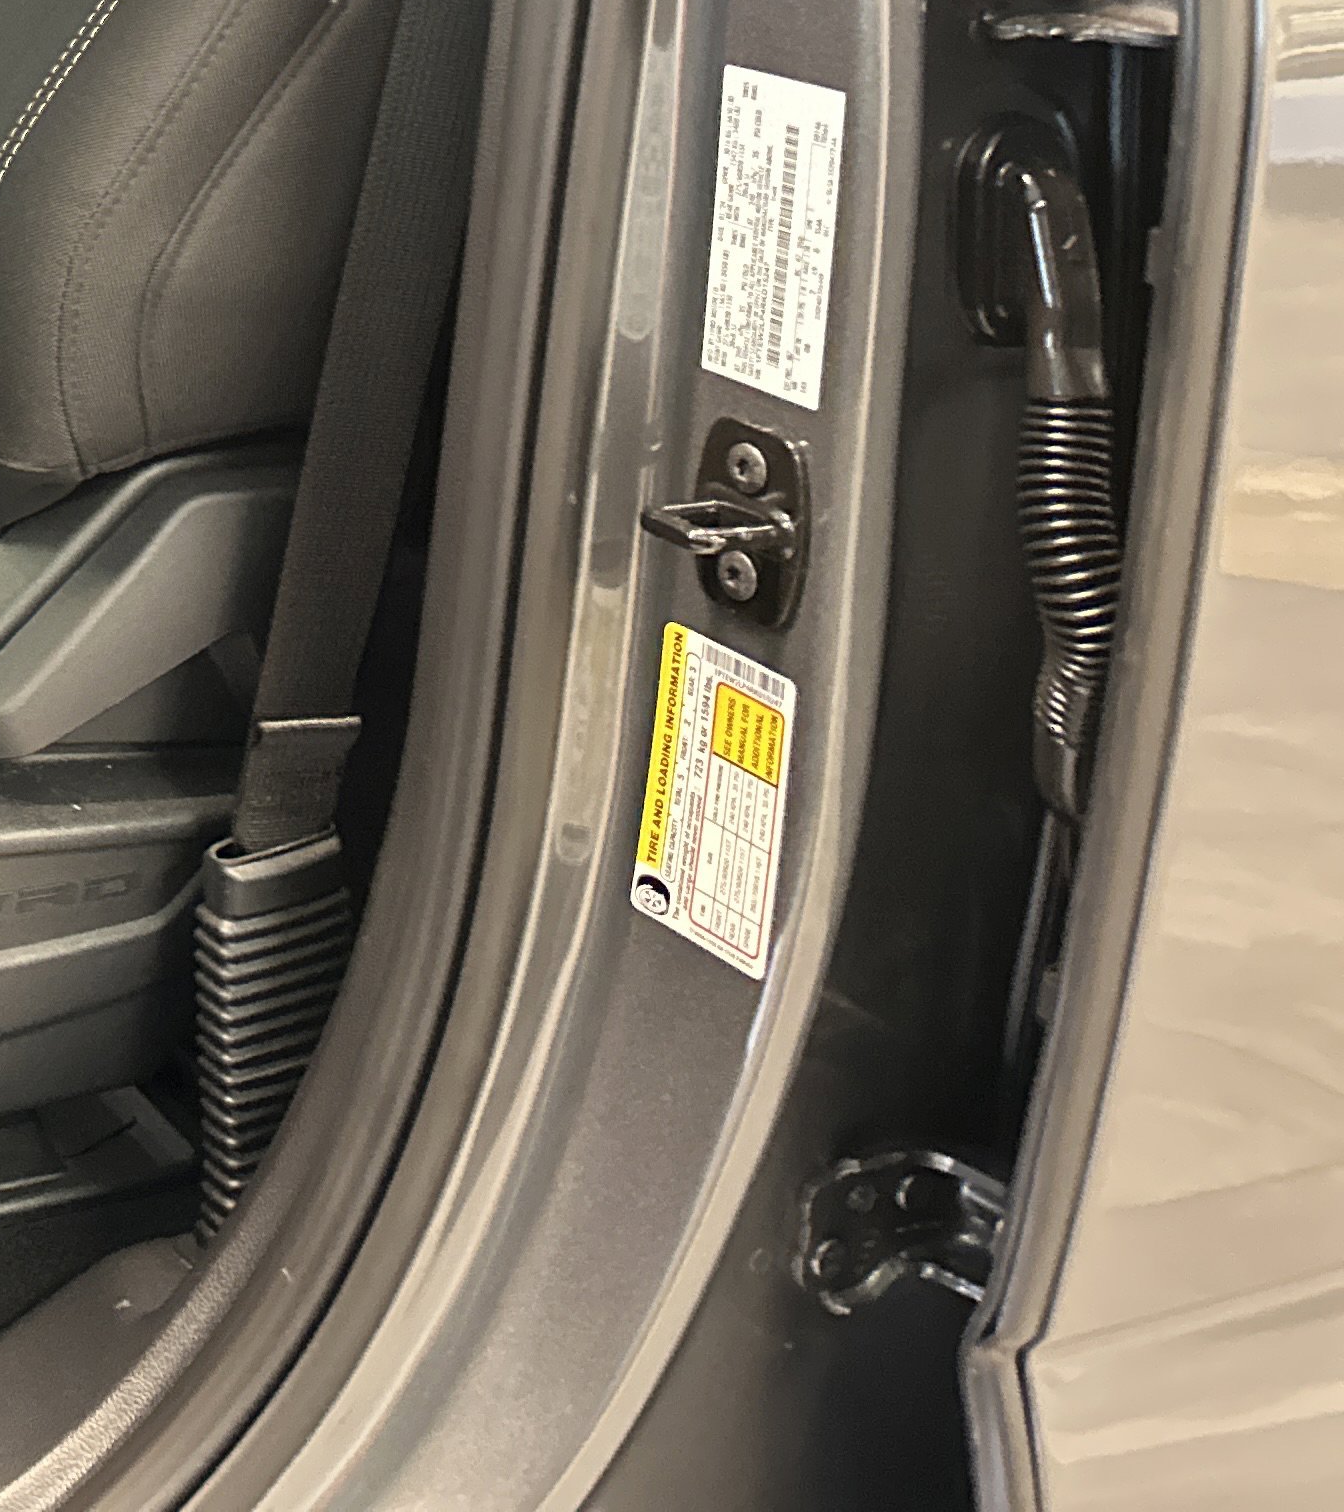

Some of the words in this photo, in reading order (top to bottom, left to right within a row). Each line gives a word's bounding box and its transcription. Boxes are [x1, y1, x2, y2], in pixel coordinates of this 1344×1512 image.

[663, 630, 684, 730] INFORMATION
[689, 665, 696, 673] 3
[700, 693, 711, 722] 1594
[724, 695, 736, 738] OWNERS
[740, 702, 750, 724] FOR
[696, 738, 707, 754] kg
[700, 724, 708, 738] or
[721, 736, 731, 757] SEE
[735, 724, 747, 765] MANUAL
[750, 711, 764, 770] ADDITIONAL
[764, 713, 779, 781] INFORMATION
[655, 731, 672, 796] LOADING
[693, 756, 703, 779] 723
[650, 794, 663, 829] AND
[646, 828, 659, 865] TIRE
